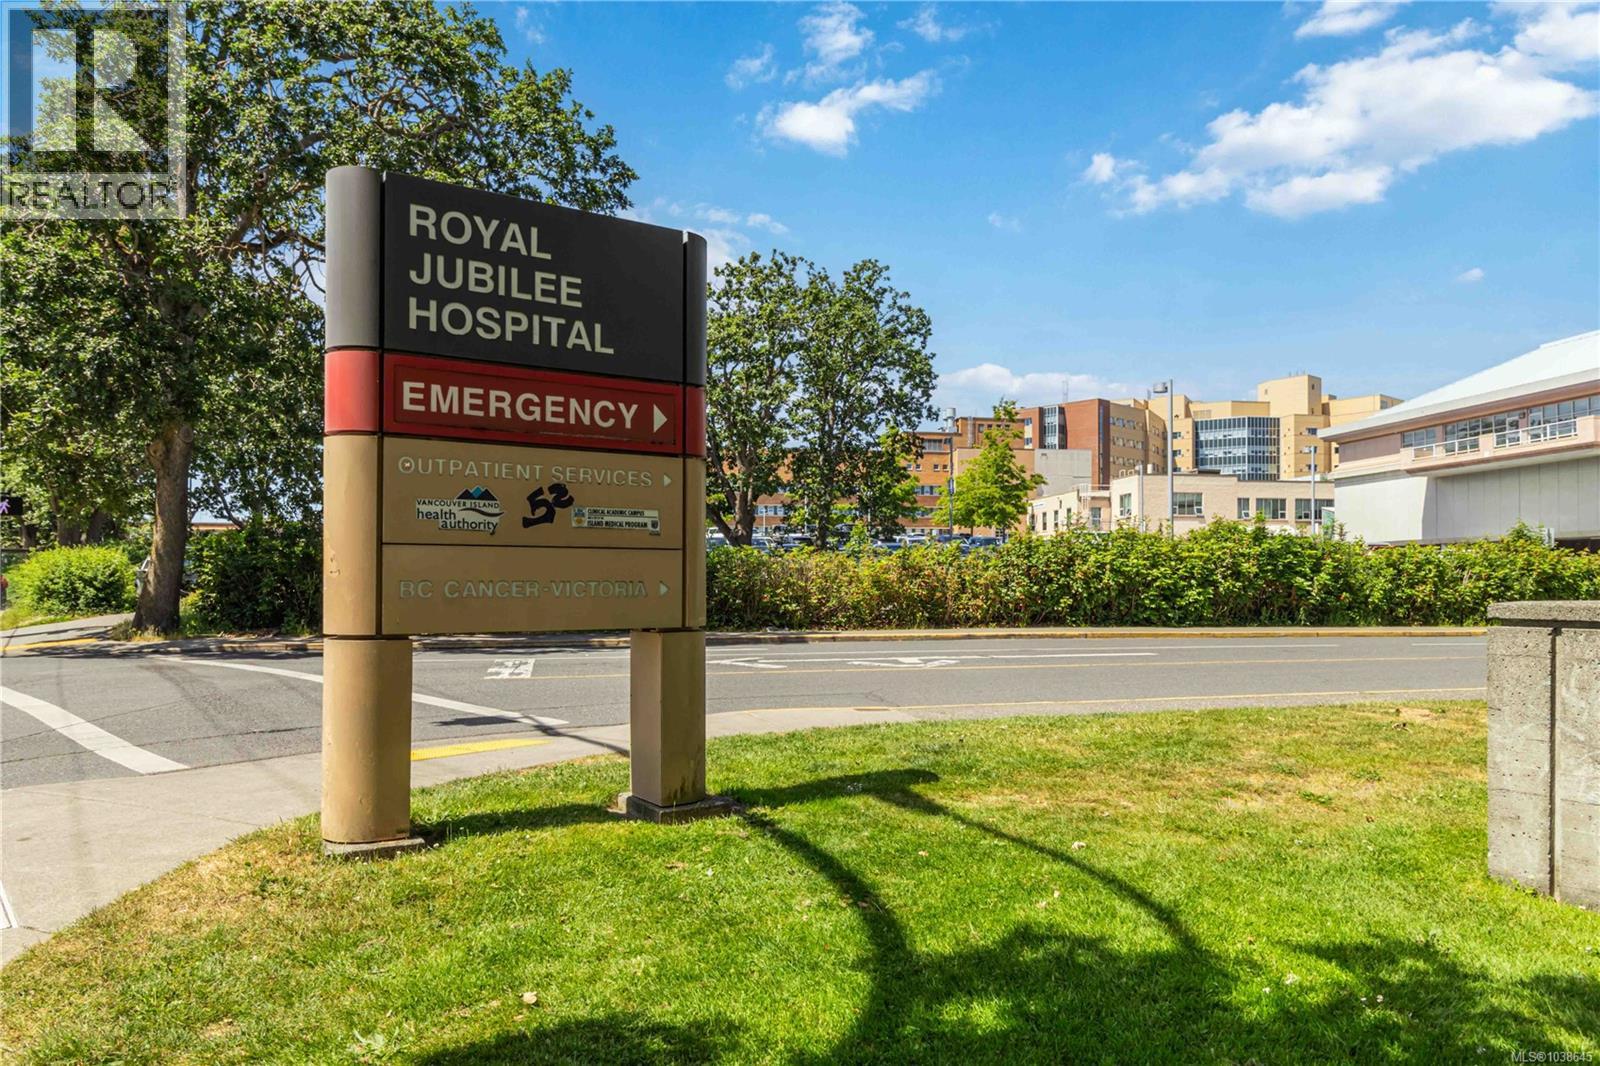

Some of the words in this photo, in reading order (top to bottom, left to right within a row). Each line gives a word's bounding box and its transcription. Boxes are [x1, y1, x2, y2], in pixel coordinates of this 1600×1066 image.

[408, 203, 552, 260] ROYAL
[409, 253, 582, 308] JUBILEE
[408, 297, 615, 354] HOSPITAL
[402, 381, 638, 429] EMERGENCY
[398, 456, 543, 481] OUTPATIENT
[551, 466, 652, 487] SERVICES
[416, 499, 467, 508] VANCOUVER
[416, 508, 456, 521] health
[440, 518, 498, 533] authority
[605, 520, 624, 528] MEDICAL
[399, 580, 434, 598] BC
